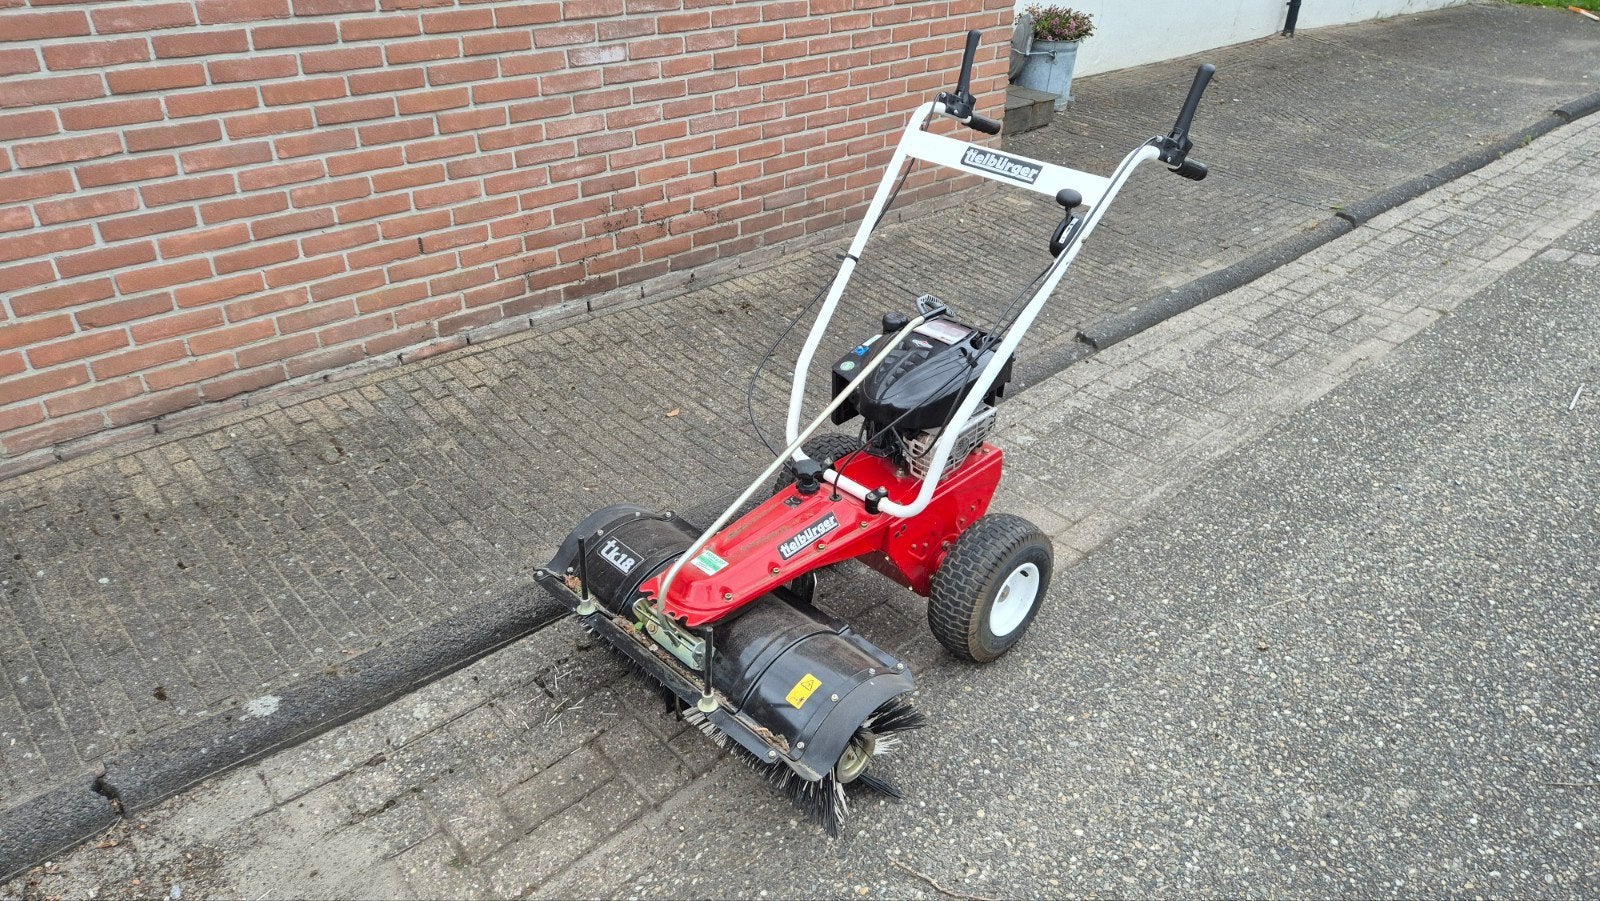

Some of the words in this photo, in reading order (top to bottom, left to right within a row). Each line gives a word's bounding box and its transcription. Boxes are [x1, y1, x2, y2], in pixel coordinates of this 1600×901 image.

[964, 148, 1039, 181] tielbürger
[780, 515, 837, 557] tielbürger
[600, 540, 636, 573] tk18
